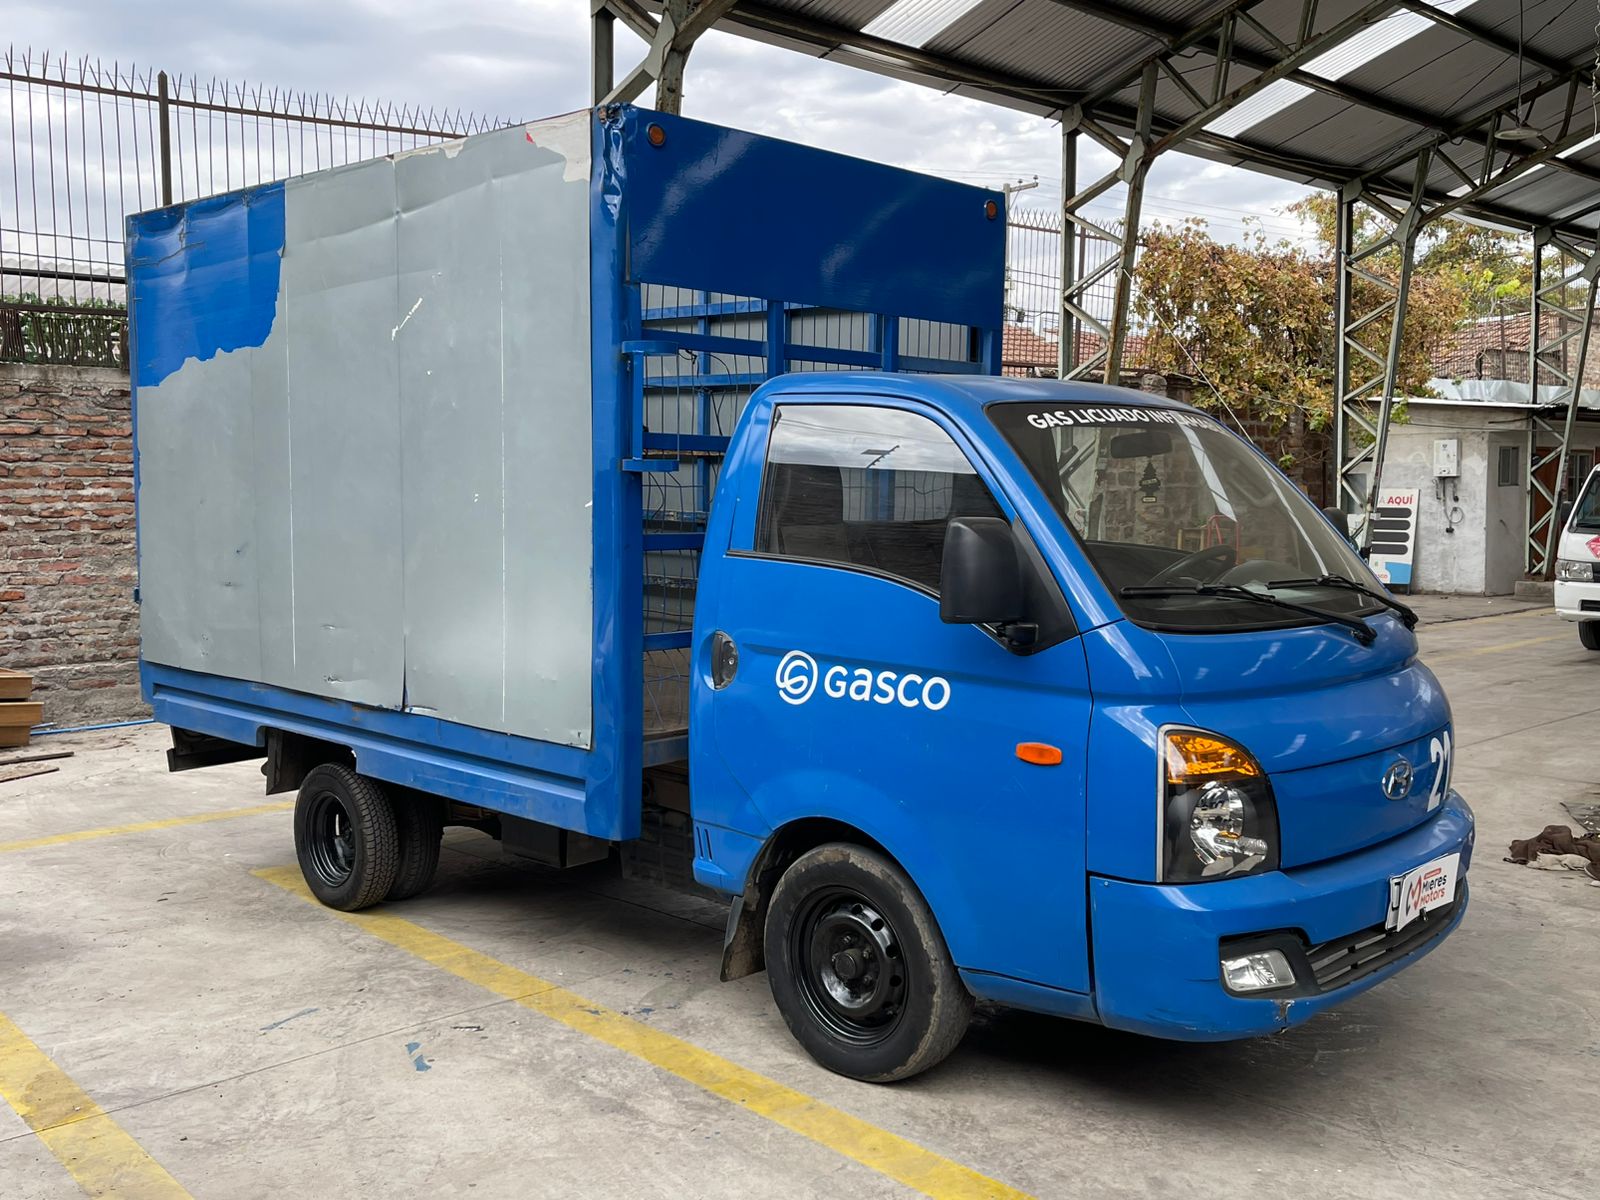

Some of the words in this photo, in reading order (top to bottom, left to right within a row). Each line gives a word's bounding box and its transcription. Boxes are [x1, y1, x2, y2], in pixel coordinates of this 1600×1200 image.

[1027, 410, 1075, 429] GAS
[1070, 408, 1150, 426] LICUADO
[1387, 494, 1414, 505] AQUÍ
[1426, 730, 1452, 813] 21
